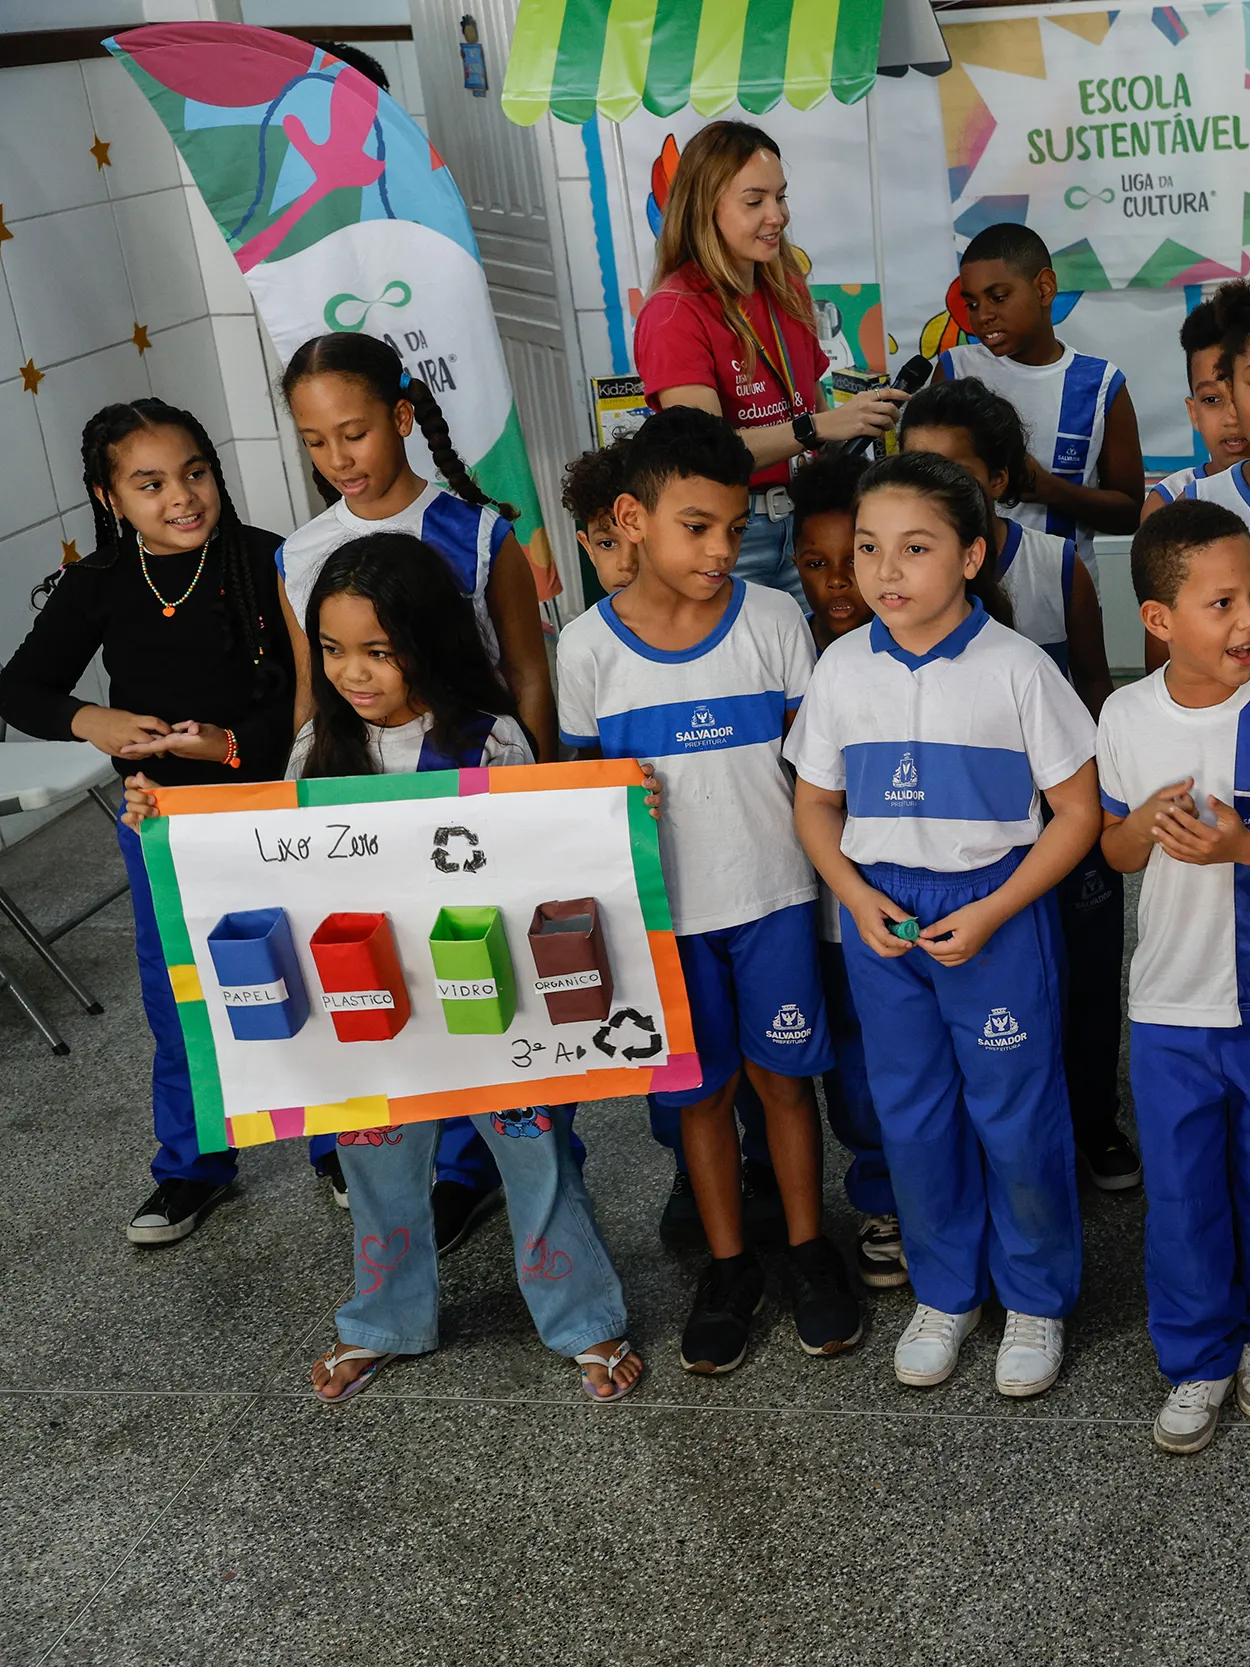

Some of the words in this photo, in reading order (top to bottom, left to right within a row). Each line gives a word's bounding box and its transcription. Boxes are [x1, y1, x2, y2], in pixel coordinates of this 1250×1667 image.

[1078, 72, 1192, 115] ESCOLA
[1027, 112, 1250, 165] SUSTENTÁVEL
[1121, 173, 1154, 192] LIGA
[1158, 175, 1174, 188] DA
[404, 329, 428, 352] DA
[794, 391, 804, 407] &
[675, 726, 734, 742] SALVADOR
[684, 738, 727, 749] PREFEITURA
[254, 827, 312, 862] Lixo
[325, 824, 379, 859] Zero
[223, 990, 275, 1001] PAPEL
[765, 1027, 812, 1039] SALVADOR
[977, 1031, 1028, 1047] SALVADOR
[555, 1042, 574, 1064] A
